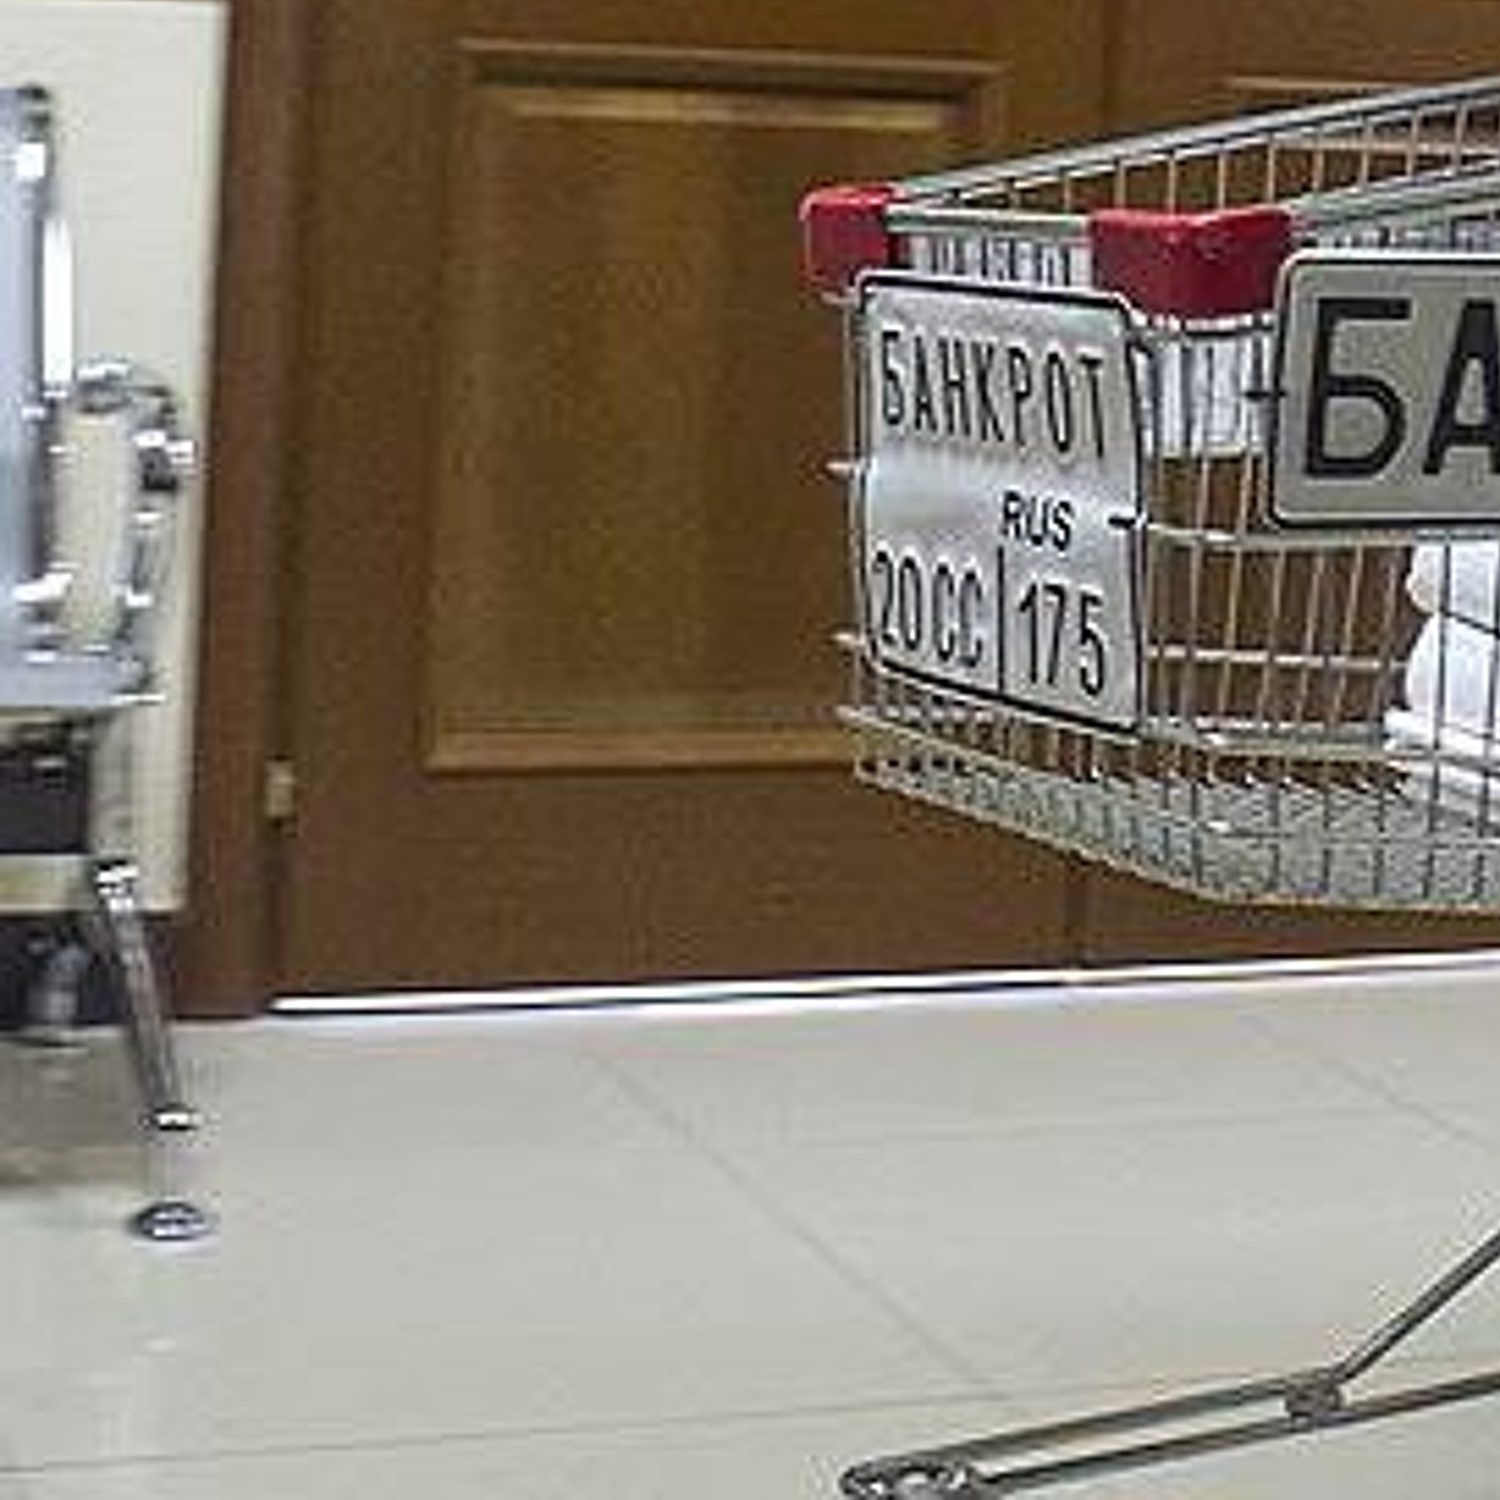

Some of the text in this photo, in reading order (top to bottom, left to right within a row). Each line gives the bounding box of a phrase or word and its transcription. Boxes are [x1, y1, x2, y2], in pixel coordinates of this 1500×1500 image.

[880, 330, 1104, 459] БАНКРОТ
[1002, 490, 1073, 551] RUS
[1018, 582, 1105, 697] 175
